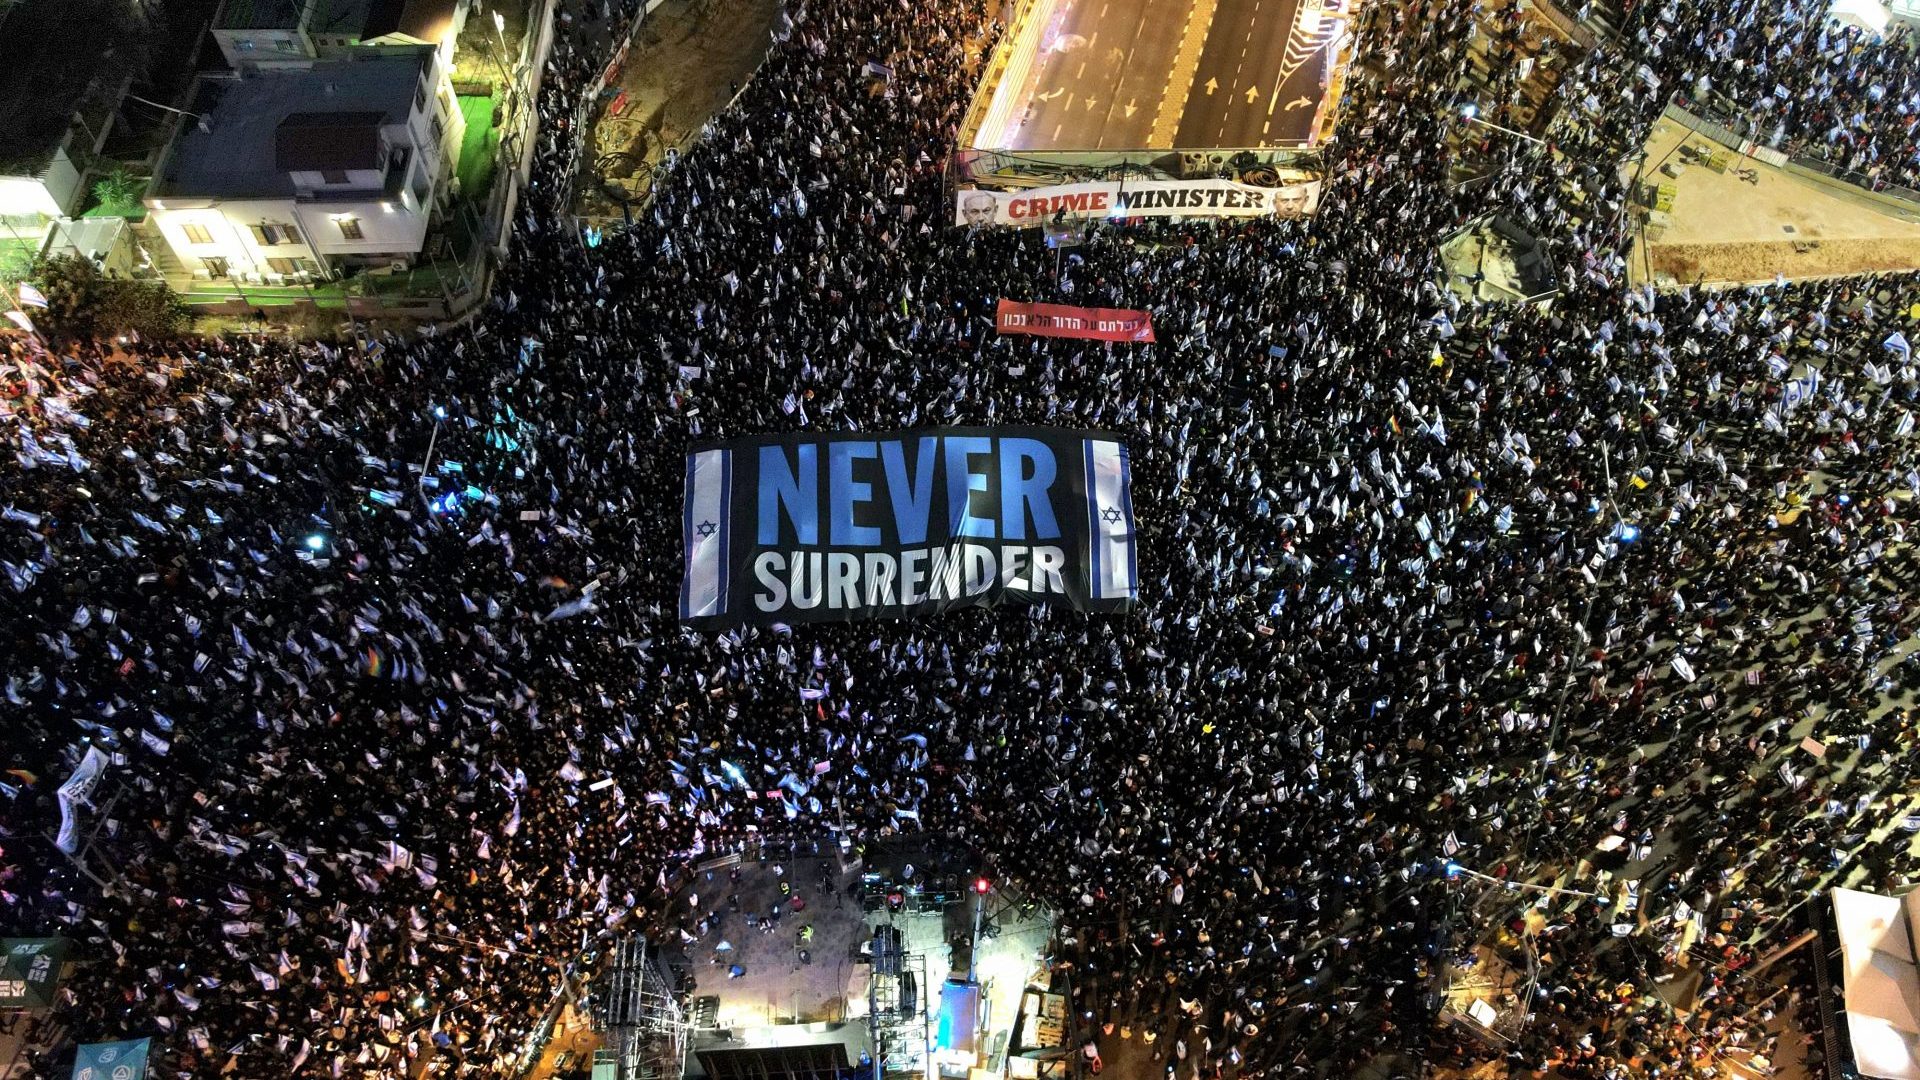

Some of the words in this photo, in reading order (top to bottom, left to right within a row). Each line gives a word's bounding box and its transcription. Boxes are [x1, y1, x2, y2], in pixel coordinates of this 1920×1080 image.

[1009, 192, 1108, 218] CRIME
[1117, 189, 1264, 209] MINISTER
[1003, 312, 1026, 327] נכון
[1052, 316, 1081, 330] הדור
[757, 436, 1062, 546] NEVER
[754, 542, 1065, 612] SURRENDER
